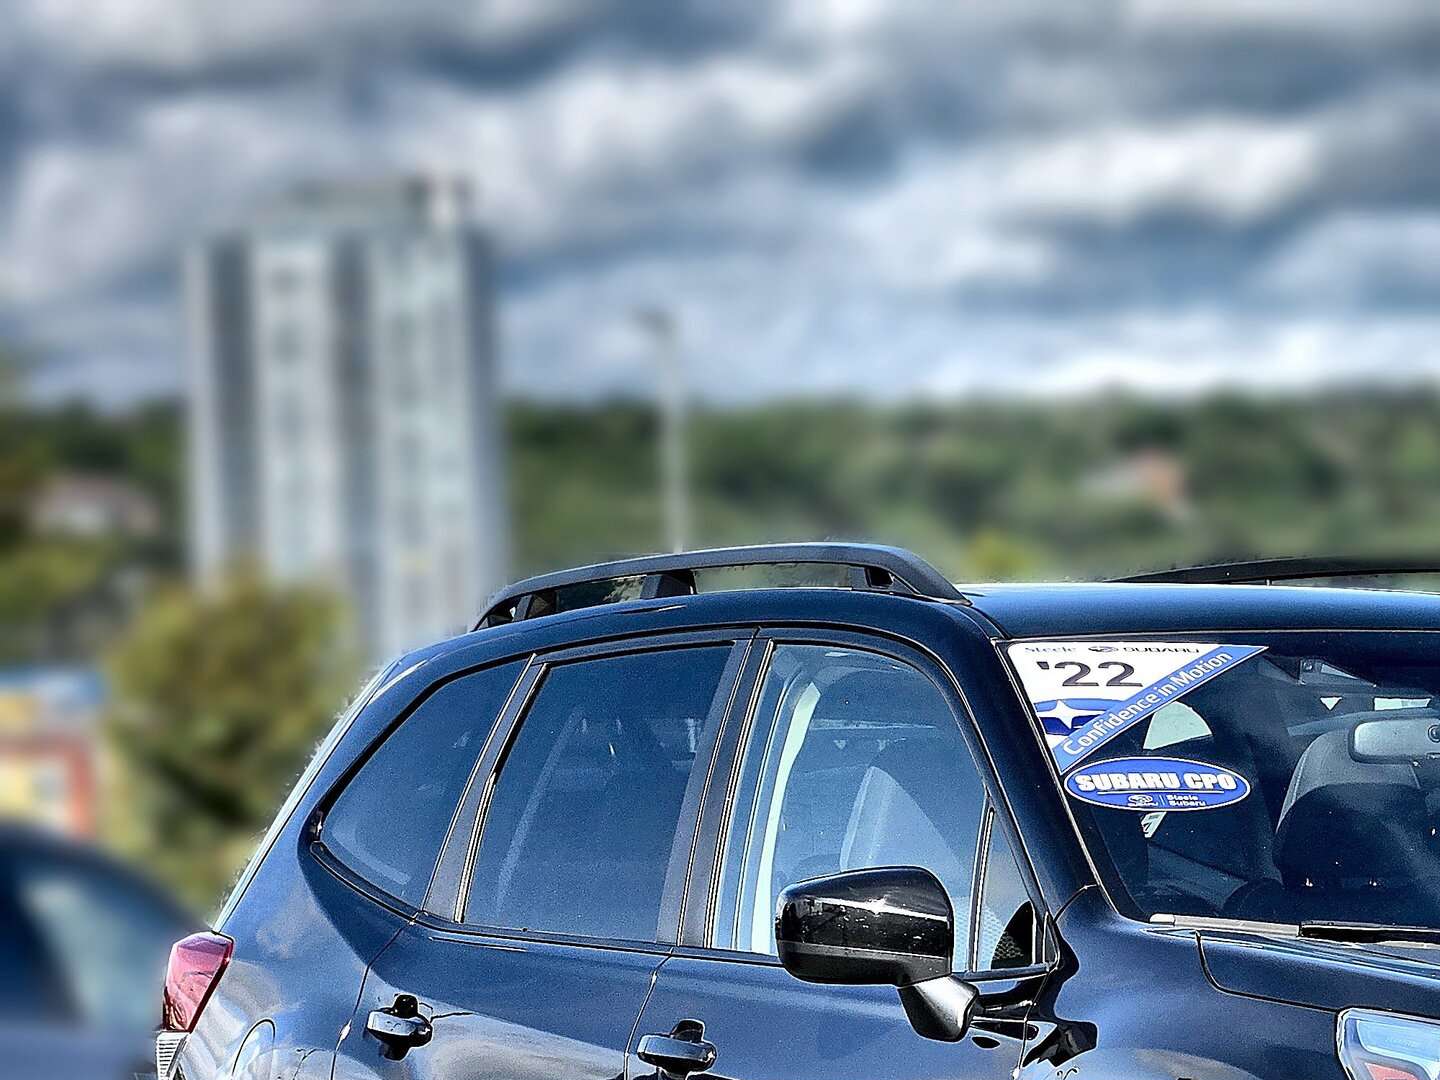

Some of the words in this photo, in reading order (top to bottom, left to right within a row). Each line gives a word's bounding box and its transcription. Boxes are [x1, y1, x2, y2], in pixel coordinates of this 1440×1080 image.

[1036, 660, 1143, 688] '22
[1063, 691, 1162, 756] Confidence
[1157, 684, 1178, 700] in
[1173, 652, 1234, 688] Motion
[1075, 772, 1181, 791] SUBARU
[1183, 772, 1238, 790] CPO
